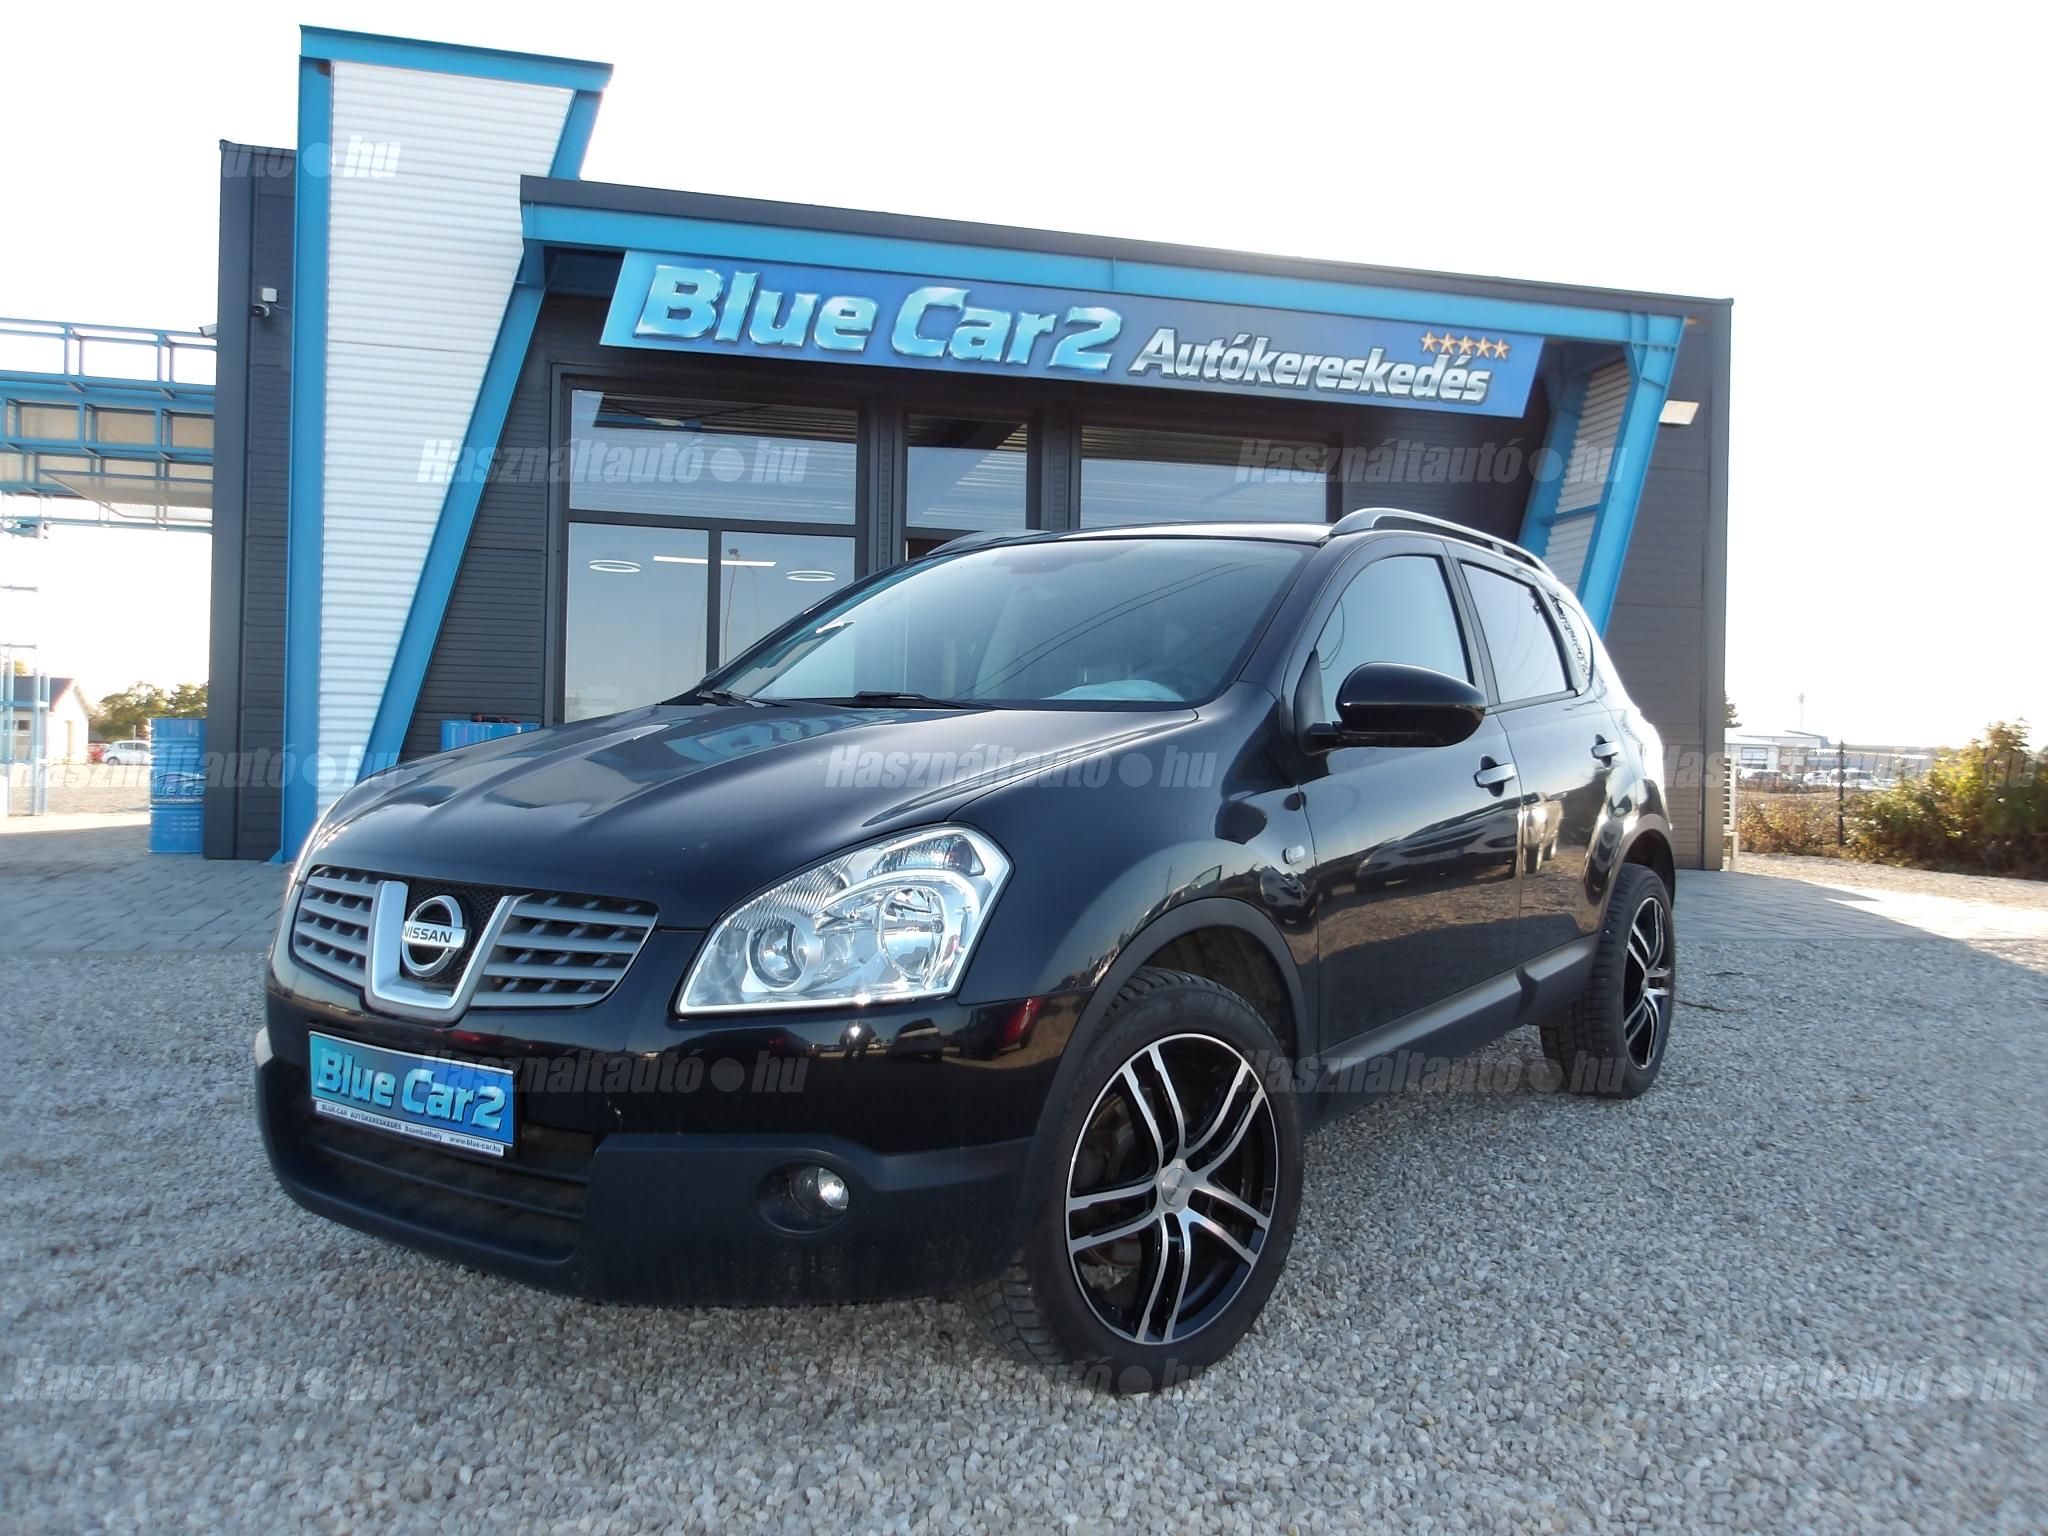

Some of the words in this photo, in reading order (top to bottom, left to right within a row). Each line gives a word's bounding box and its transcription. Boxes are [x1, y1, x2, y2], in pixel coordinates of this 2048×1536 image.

[633, 264, 878, 354] Blue
[890, 286, 1123, 372] Car2
[1128, 328, 1492, 403] Autókereskedés
[403, 926, 452, 944] NISSAN
[316, 1048, 396, 1108] Blue
[402, 1068, 506, 1131] Car2
